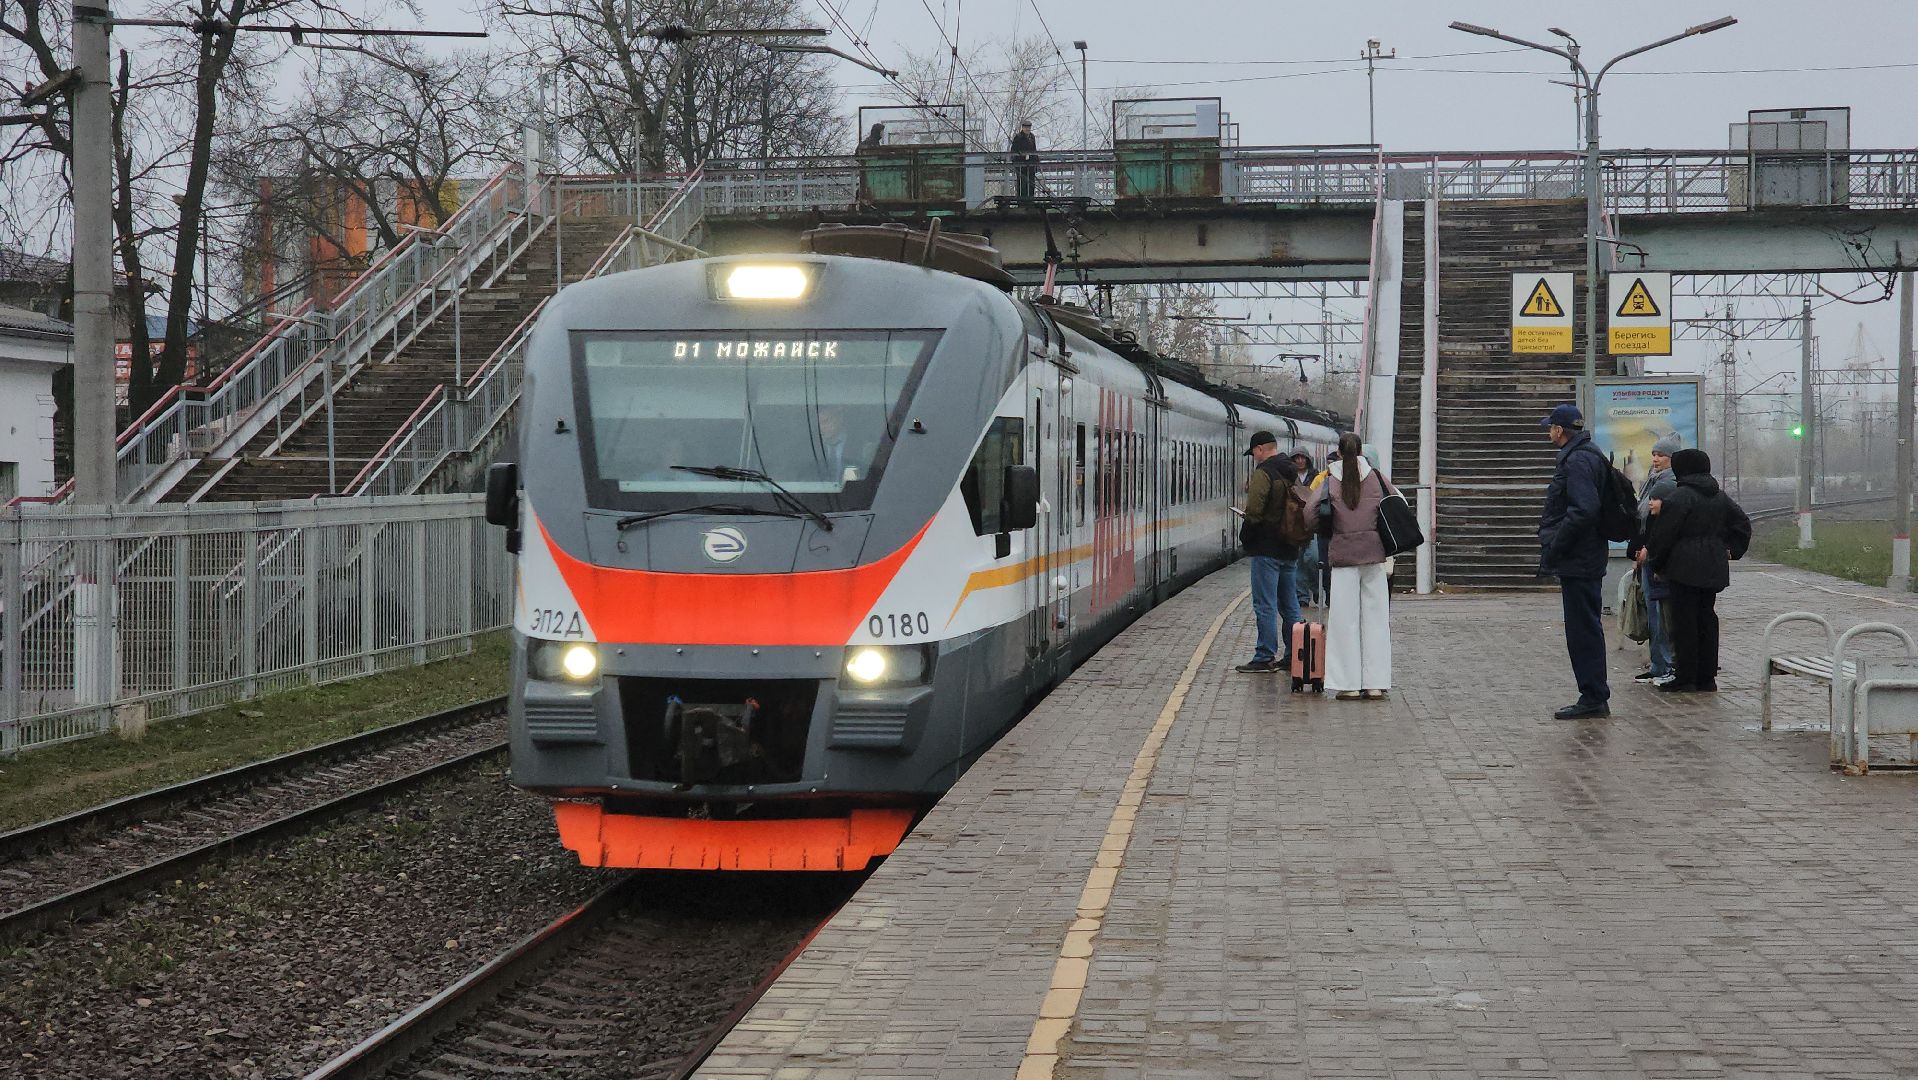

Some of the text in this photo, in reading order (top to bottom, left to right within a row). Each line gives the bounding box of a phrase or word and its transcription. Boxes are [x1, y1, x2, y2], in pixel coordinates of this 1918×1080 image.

[1614, 331, 1656, 341] Берегись
[1614, 341, 1650, 351] поезда!
[530, 608, 584, 638] ЭП2Д
[869, 611, 929, 638] 0180
